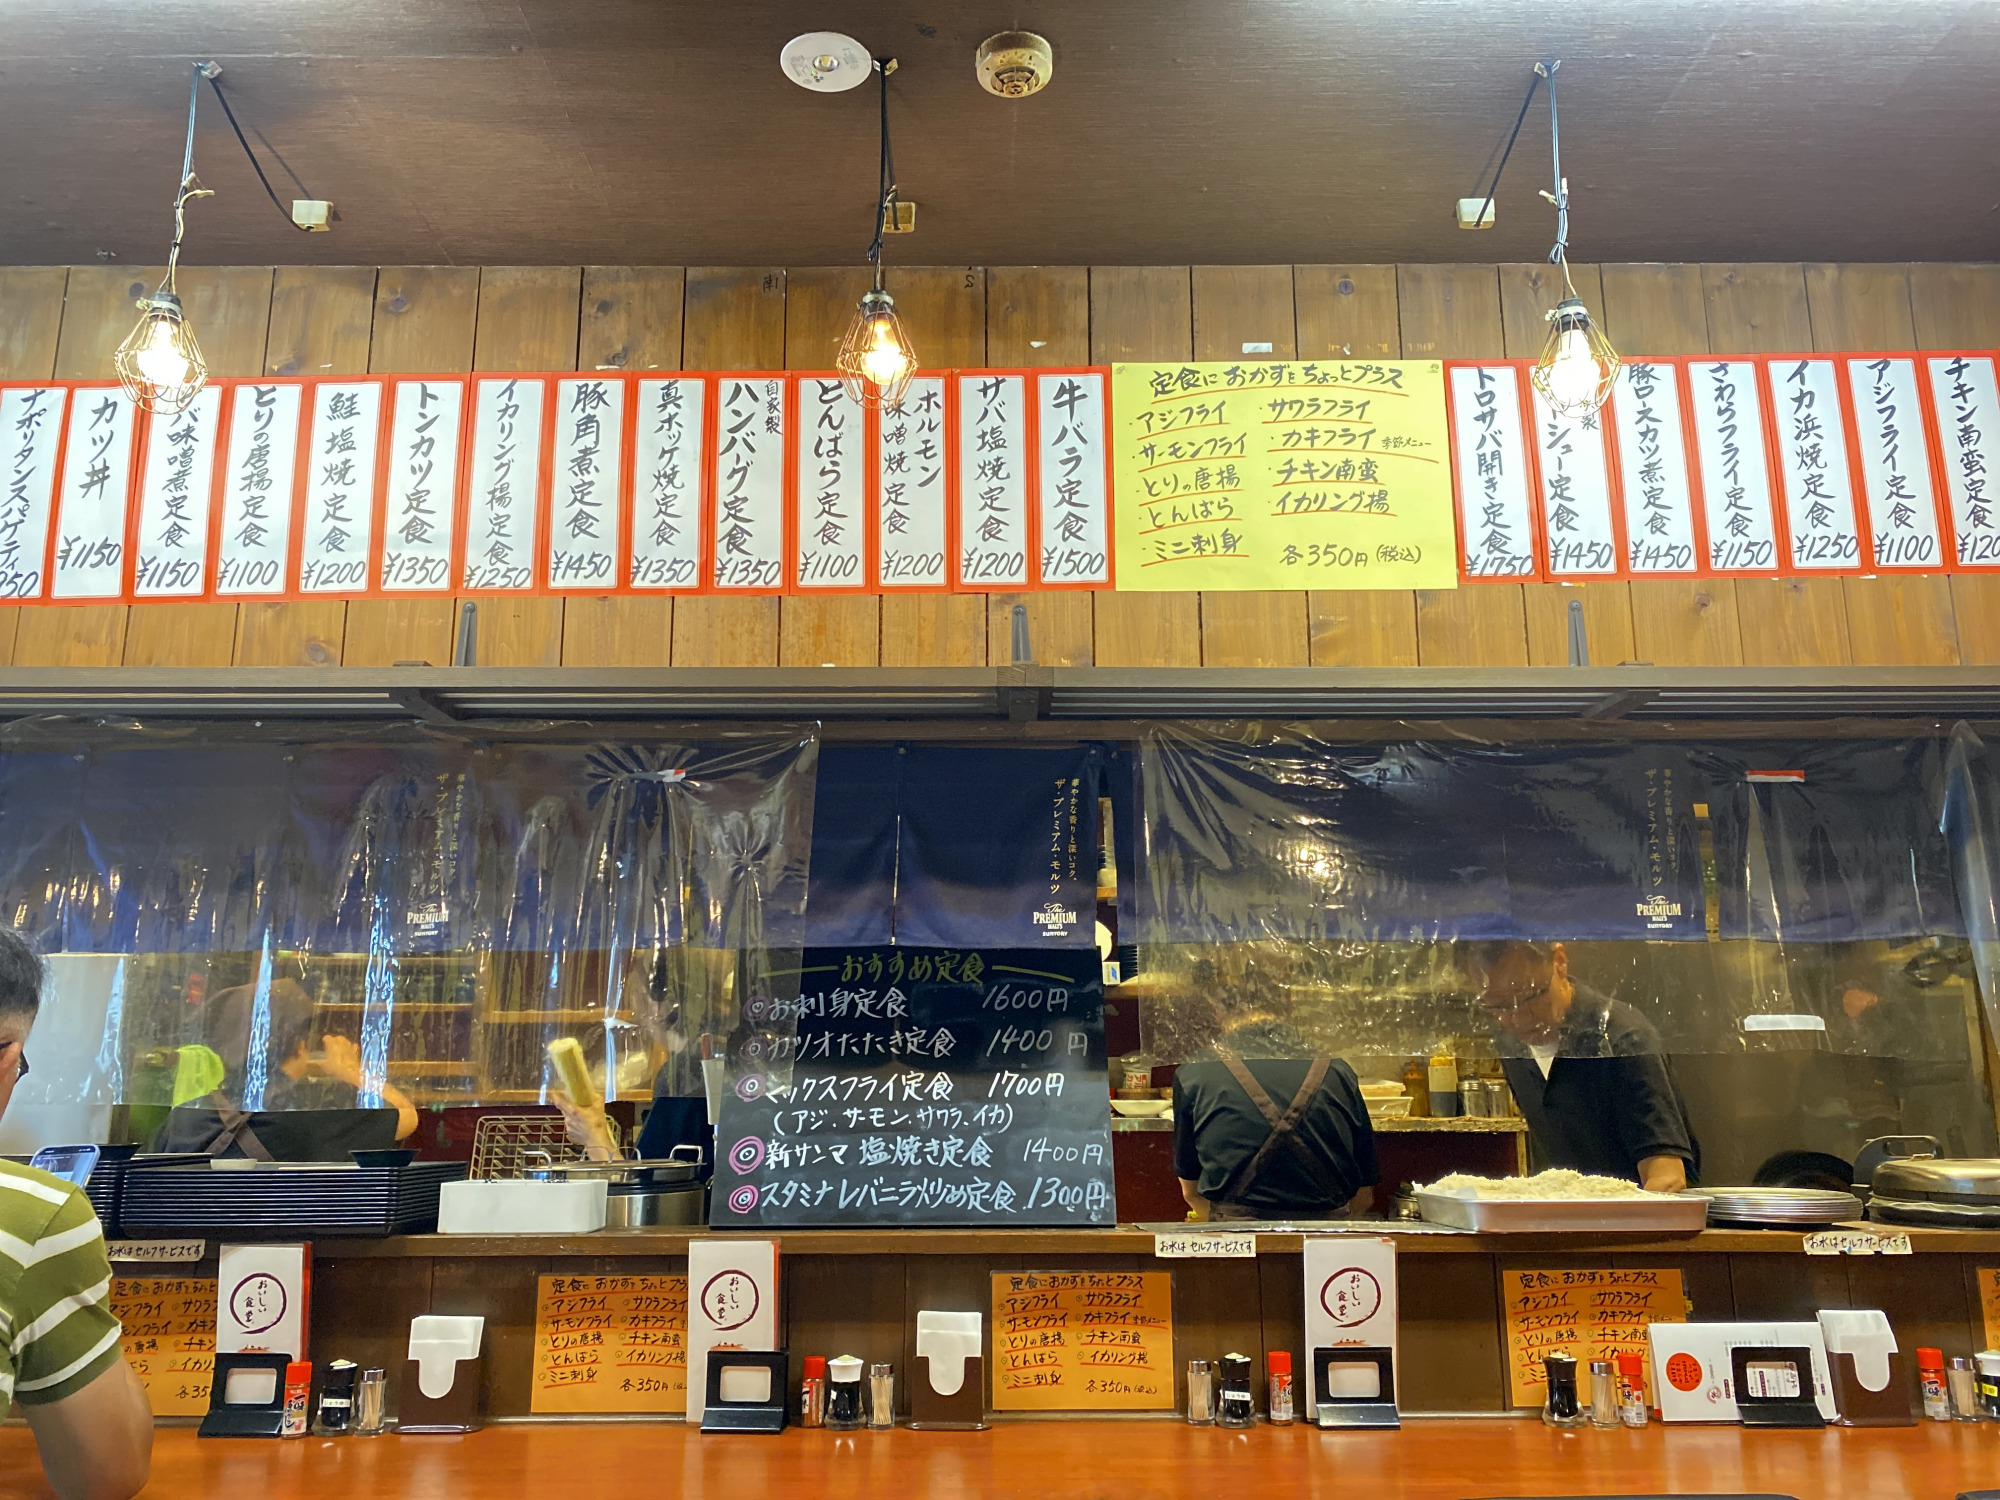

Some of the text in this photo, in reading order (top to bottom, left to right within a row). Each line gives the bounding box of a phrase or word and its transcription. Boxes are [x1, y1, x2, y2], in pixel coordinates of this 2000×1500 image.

[765, 380, 784, 435] 自家製
[1137, 400, 1227, 434] アジフライ
[1267, 397, 1371, 421] サワラフライ
[79, 396, 118, 500] カツ丼
[913, 389, 942, 488] ホルモン
[1139, 432, 1248, 466] サーモンフライ
[1281, 427, 1377, 451] カキフライ
[1628, 363, 1674, 536] 豚ロースカツ煮定食
[1709, 362, 1753, 537] さわらフライ定食
[1786, 359, 1836, 528] イカ浜焼定食
[1866, 359, 1916, 529] アジフライ定食
[1944, 356, 1995, 528] チキン南蛮定食
[157, 388, 202, 548] バ味噌煮定食
[235, 386, 278, 548] とりの唐揚定食
[319, 391, 361, 553] 鮭塩焼定食
[399, 383, 440, 544] トンカツ定食
[483, 378, 520, 566] イカリング揚定食
[565, 381, 610, 539] 豚角煮定食
[649, 379, 685, 546] 真ホッケ焼定食
[718, 382, 760, 555] ハンバーグ定食
[813, 379, 849, 546] とんばら定食
[882, 400, 911, 534] 味噌焼定食
[974, 377, 1011, 542] サバ塩焼定食
[1052, 378, 1090, 542] 牛バラ定食
[1276, 457, 1379, 484] チキン南蛮
[1474, 367, 1513, 555] トロサバ開き定食
[1546, 407, 1579, 532] ーシュー定食
[0, 389, 47, 570] ナポリタンスパゲティ
[1142, 464, 1241, 498] とりの唐揚
[1148, 497, 1235, 529] とんばら
[1276, 489, 1390, 515] イカリング揚
[57, 536, 122, 570] ¥1150
[1153, 527, 1244, 560] ミニ刺身
[1551, 537, 1614, 569] ¥1450
[1629, 538, 1692, 569] ¥1450
[1713, 538, 1772, 568] ¥1150
[1793, 532, 1860, 563] ¥1250
[1874, 531, 1934, 565] ¥1100
[136, 555, 200, 590] ¥1150
[217, 557, 279, 589] ¥1100
[302, 559, 366, 589] ¥1200
[383, 552, 449, 586] ¥1350
[464, 566, 531, 589] ¥1250
[551, 550, 611, 582] ¥1450
[630, 555, 695, 584] ¥1350
[714, 557, 781, 586] ¥1350
[799, 550, 858, 582] ¥1100
[881, 549, 943, 580] ¥1200
[962, 547, 1023, 580] ¥1200
[1041, 547, 1105, 579] ¥1500
[1465, 553, 1535, 581] ¥1750
[407, 910, 449, 924] PREMIUM
[1033, 911, 1077, 924] PREMIUM
[1043, 902, 1065, 913] The
[1636, 903, 1681, 916] PREMIUM
[840, 951, 986, 984] おすすめ定食
[769, 984, 1070, 1021] お刺身定食 1600円
[767, 1027, 957, 1062] カツオたたき定食
[987, 1072, 1065, 1098] 1700円
[1023, 1136, 1103, 1165] 1400円
[1027, 1176, 1106, 1211] 1300円
[551, 1296, 607, 1313] アジフライ
[1006, 1292, 1060, 1313] アジフライ
[1085, 1293, 1142, 1307] サワラフライ
[1518, 1291, 1569, 1311] アジフライ
[1596, 1291, 1652, 1307] サワラフライ
[121, 1320, 171, 1336] モンフライ
[629, 1314, 676, 1330] カキフライ
[1006, 1312, 1068, 1332] サーモンフライ
[1084, 1311, 1130, 1324] カキフライ
[1519, 1310, 1579, 1330] サーモンフライ
[1599, 1310, 1644, 1323] カキフライ
[124, 1338, 158, 1353] の唐揚
[183, 1336, 217, 1351] チキン
[551, 1349, 598, 1366] とんばら
[1010, 1351, 1058, 1367] とんばら
[181, 1357, 214, 1371] イカリ
[550, 1366, 598, 1383] ミニ刺身
[1013, 1371, 1062, 1387] ミニ刺身
[176, 1384, 211, 1399] 各35
